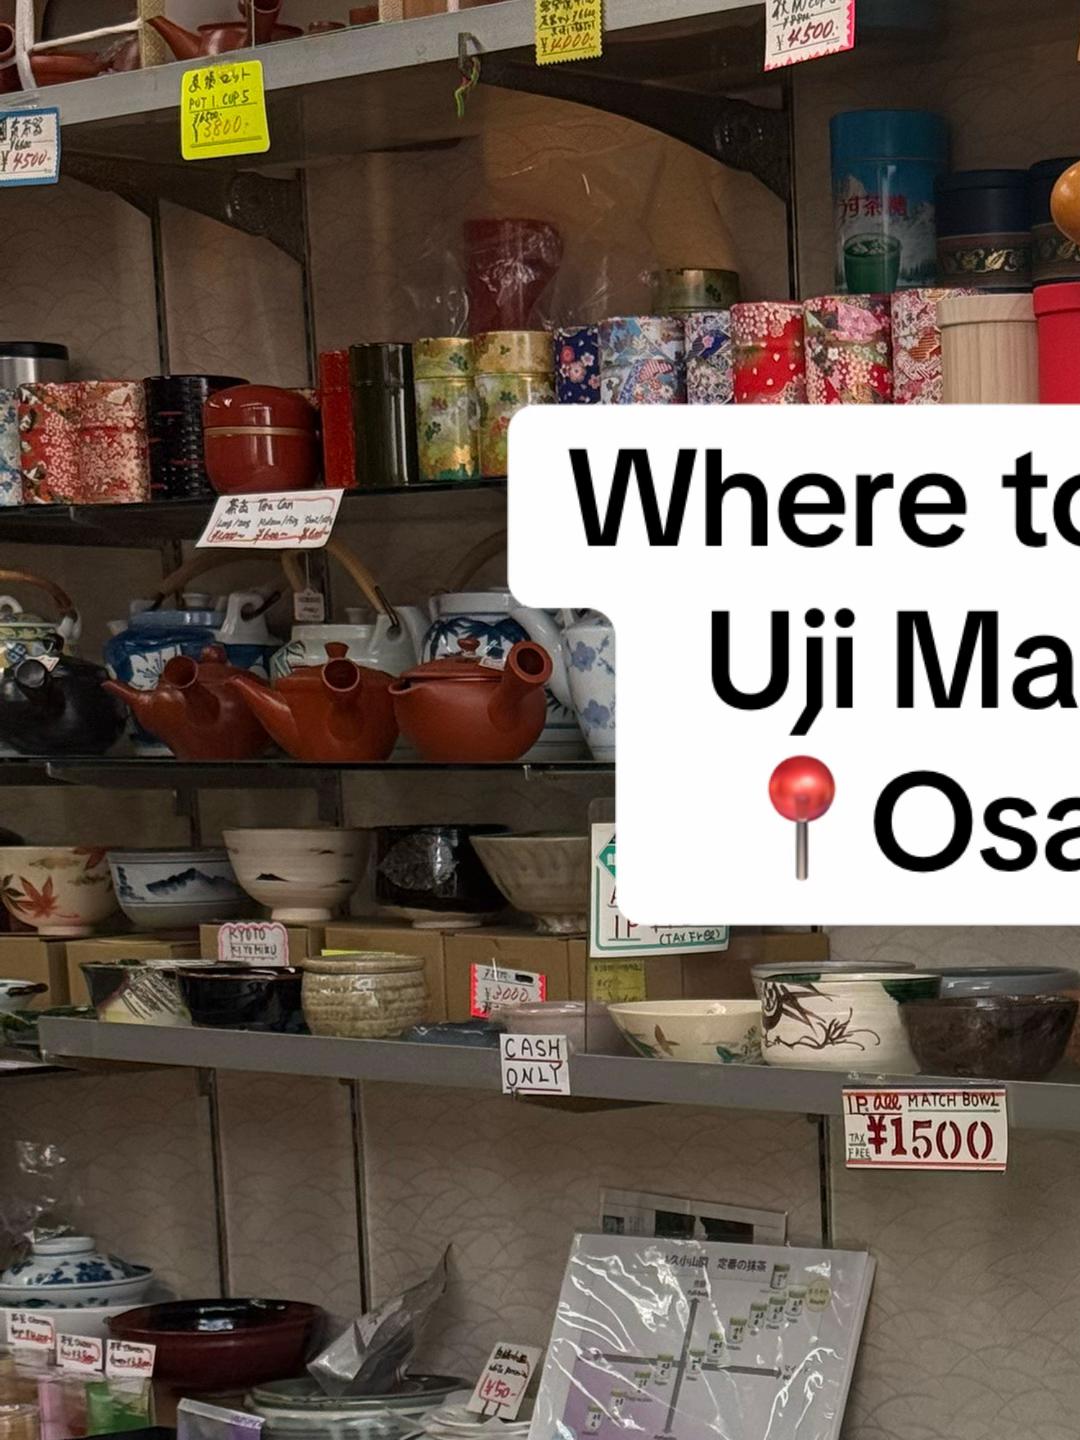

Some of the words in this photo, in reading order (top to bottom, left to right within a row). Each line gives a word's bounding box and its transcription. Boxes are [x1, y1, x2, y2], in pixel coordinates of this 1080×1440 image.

[189, 96, 208, 109] POT
[229, 927, 266, 941] KYOTO
[505, 1038, 560, 1060] CASH
[506, 1063, 562, 1087] ONLY
[908, 1092, 957, 1108] MATCH
[962, 1091, 1000, 1107] BOWL
[849, 1132, 866, 1144] TAX
[867, 1114, 993, 1160] ¥1500
[848, 1147, 871, 1159] FREE
